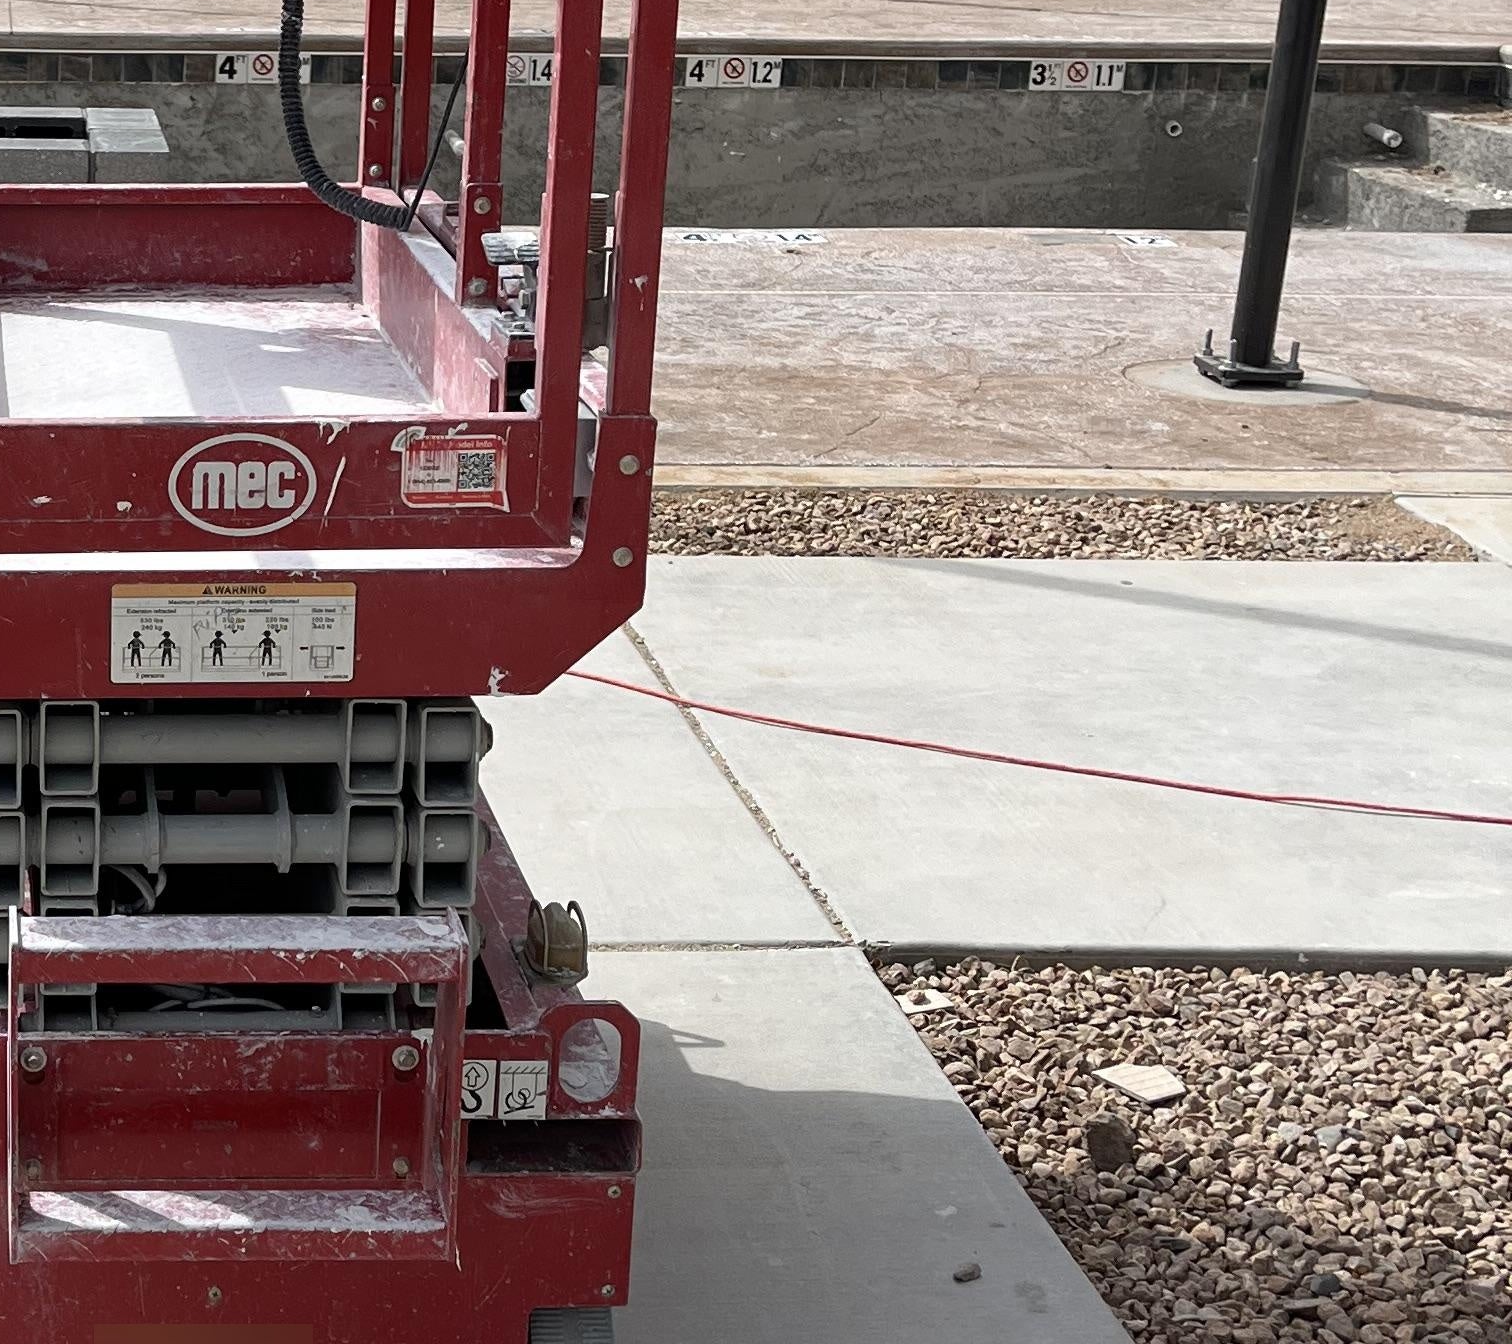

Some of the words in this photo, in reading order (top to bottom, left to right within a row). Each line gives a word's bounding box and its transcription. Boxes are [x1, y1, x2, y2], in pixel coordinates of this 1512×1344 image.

[219, 56, 237, 80] 4
[532, 59, 553, 82] 1.4
[689, 59, 705, 83] 4
[752, 61, 772, 83] 1.2
[1096, 64, 1114, 87] 1.1
[214, 585, 267, 595] WARNING
